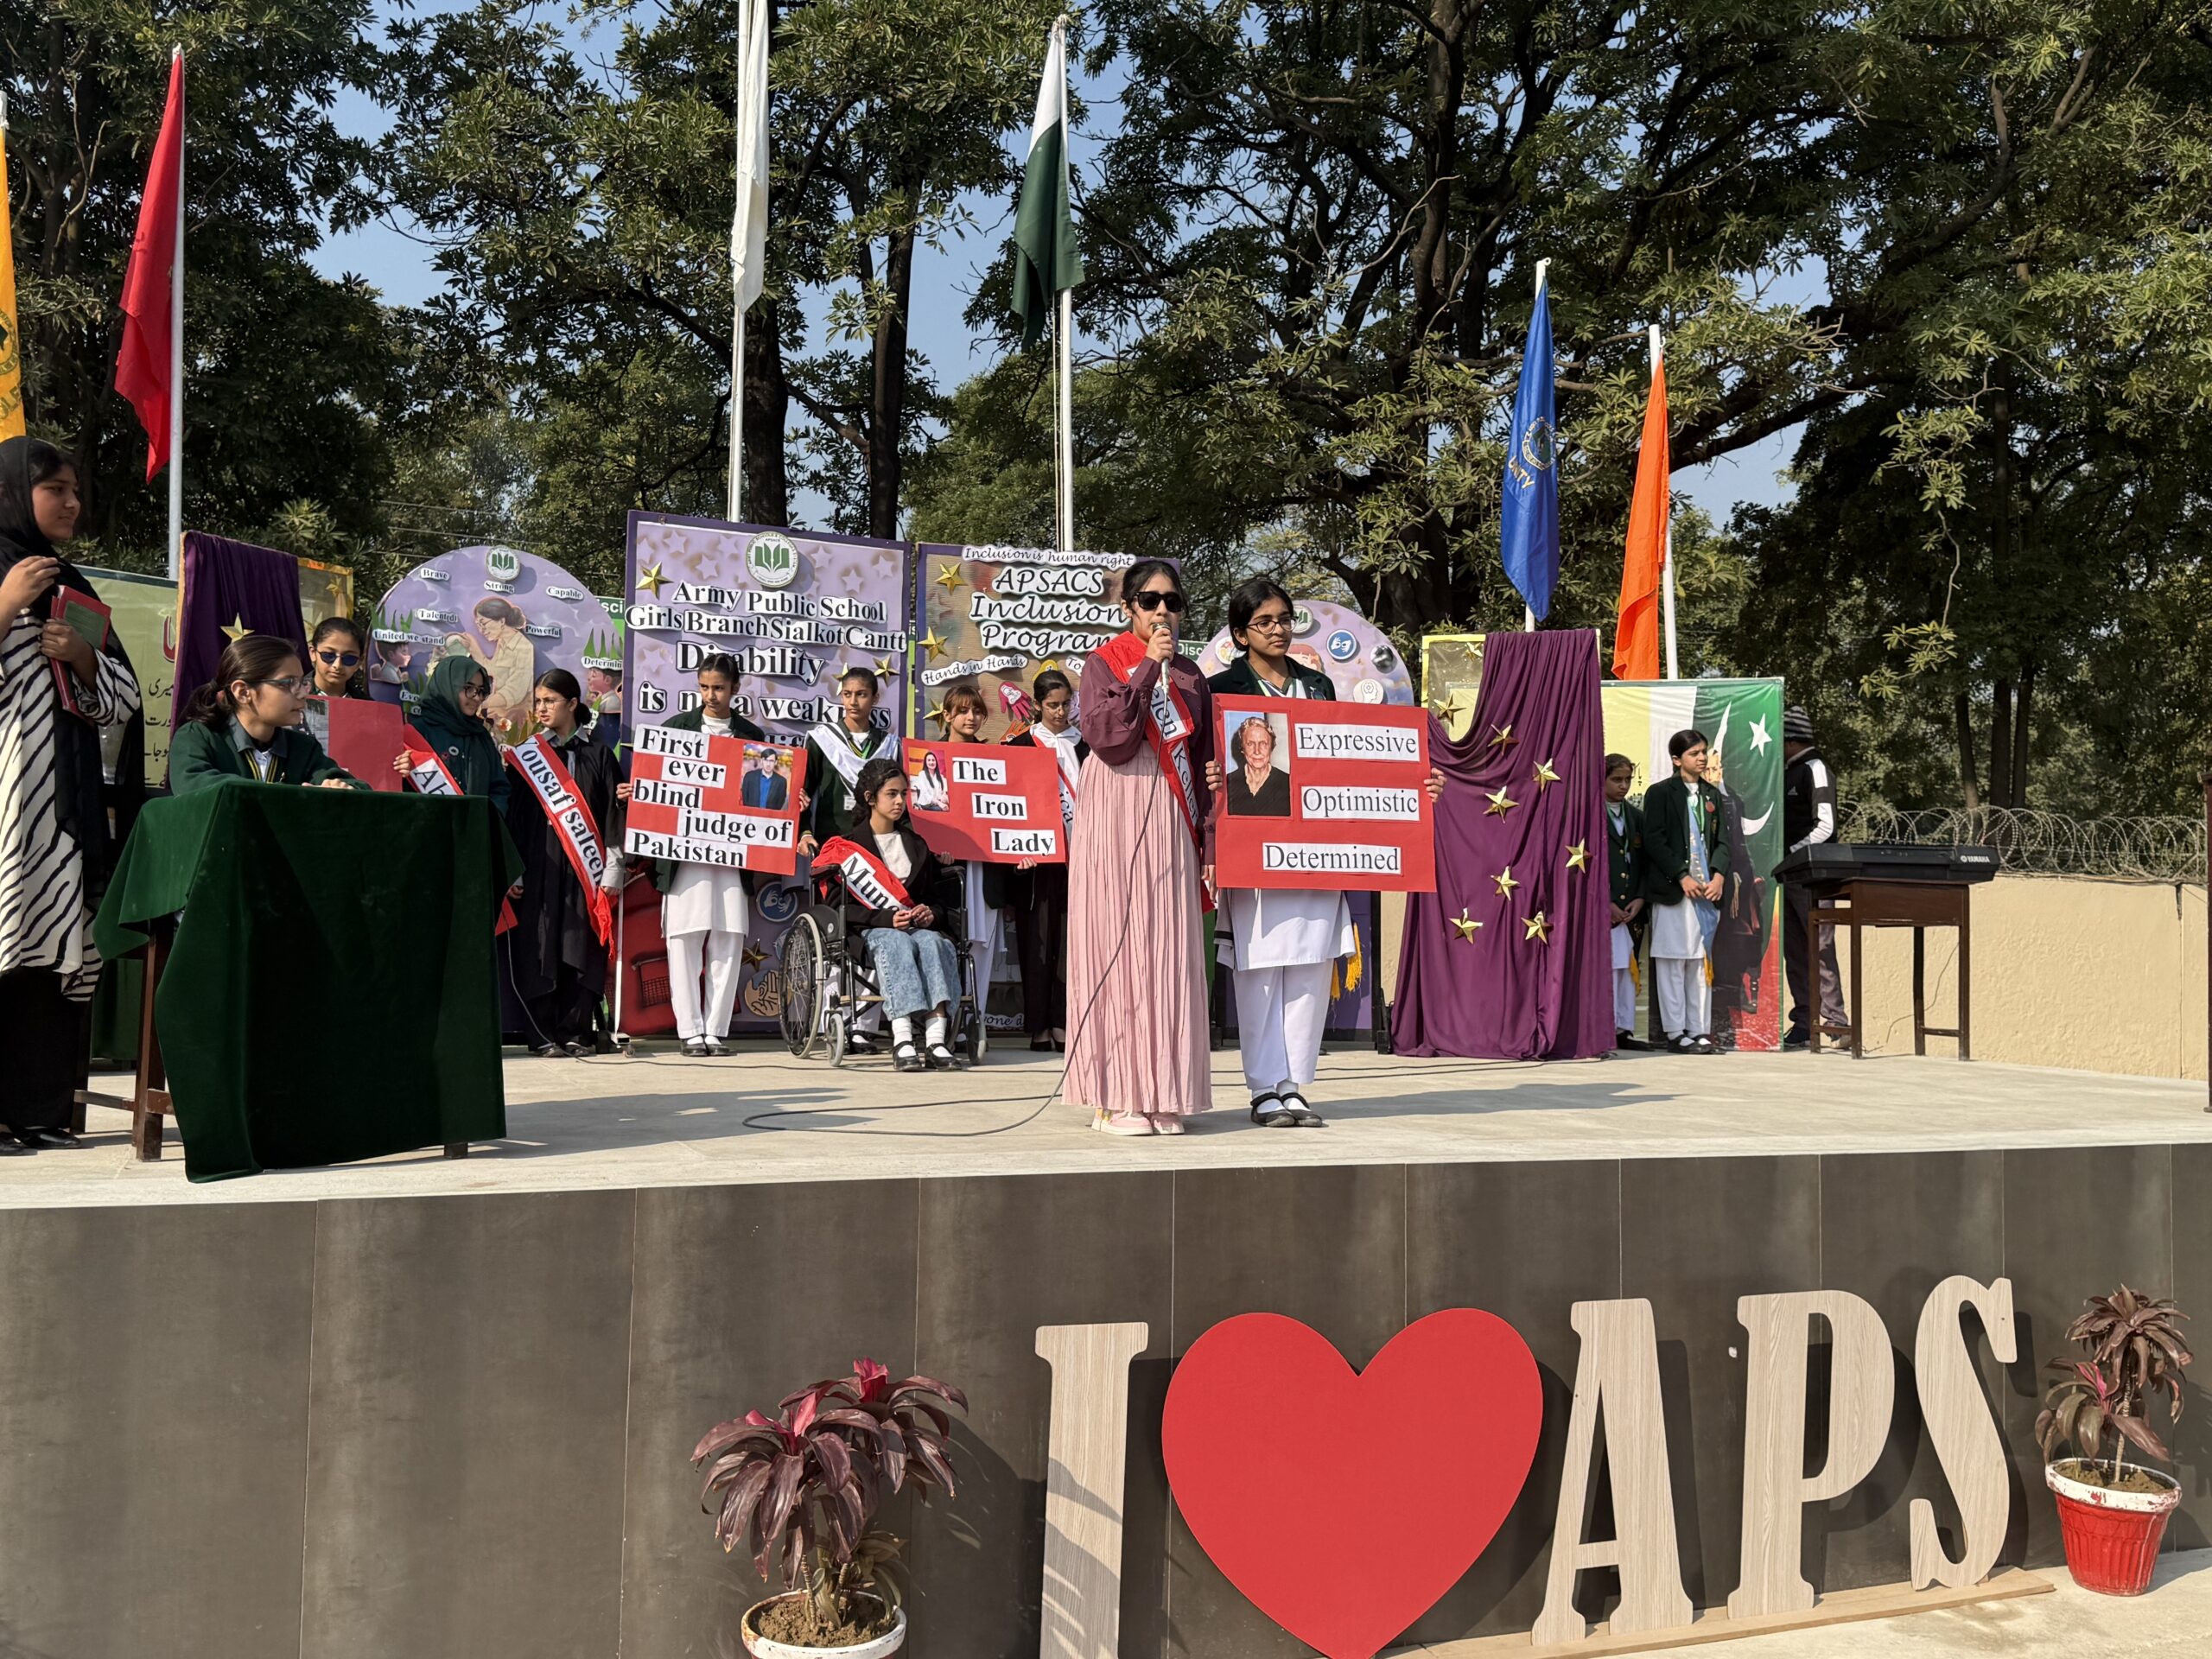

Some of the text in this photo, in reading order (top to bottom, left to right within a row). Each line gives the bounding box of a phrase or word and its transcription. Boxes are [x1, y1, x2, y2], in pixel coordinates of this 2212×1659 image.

[964, 547, 1134, 569] Inclusion is human right
[423, 569, 448, 579] Brave
[995, 569, 1103, 594] APSACS
[486, 582, 514, 594] Strong
[548, 588, 582, 600] Capable
[673, 582, 885, 621] Army Public School
[601, 601, 623, 613] sci
[971, 594, 1127, 623] Inclusion
[374, 631, 404, 641] United
[422, 636, 444, 645] stand
[525, 626, 562, 637] Powerful
[625, 605, 906, 650] Girls Branch Sialkot Cantt
[584, 657, 622, 668] Determin
[1178, 643, 1205, 656] Disc
[679, 643, 824, 684] Dability
[925, 665, 967, 683] Hands
[968, 660, 982, 672] in
[987, 654, 1026, 671] Hands
[641, 683, 665, 711] is
[734, 696, 750, 715] a
[760, 696, 891, 729] weakss
[1150, 688, 1178, 737] elen
[641, 728, 705, 759] First
[1298, 727, 1417, 757] Expressive
[668, 760, 725, 782] ever
[953, 760, 998, 782] The
[1173, 747, 1198, 820] Keller
[634, 779, 701, 809] blind
[975, 794, 1025, 817] Iron
[1303, 787, 1418, 817] Optimistic
[683, 810, 792, 843] judge of
[632, 832, 745, 867] Pakistan
[993, 830, 1053, 856] Lady
[1264, 844, 1399, 871] Determined
[984, 1016, 1013, 1026] one
[1035, 1274, 2018, 1659] I APS
